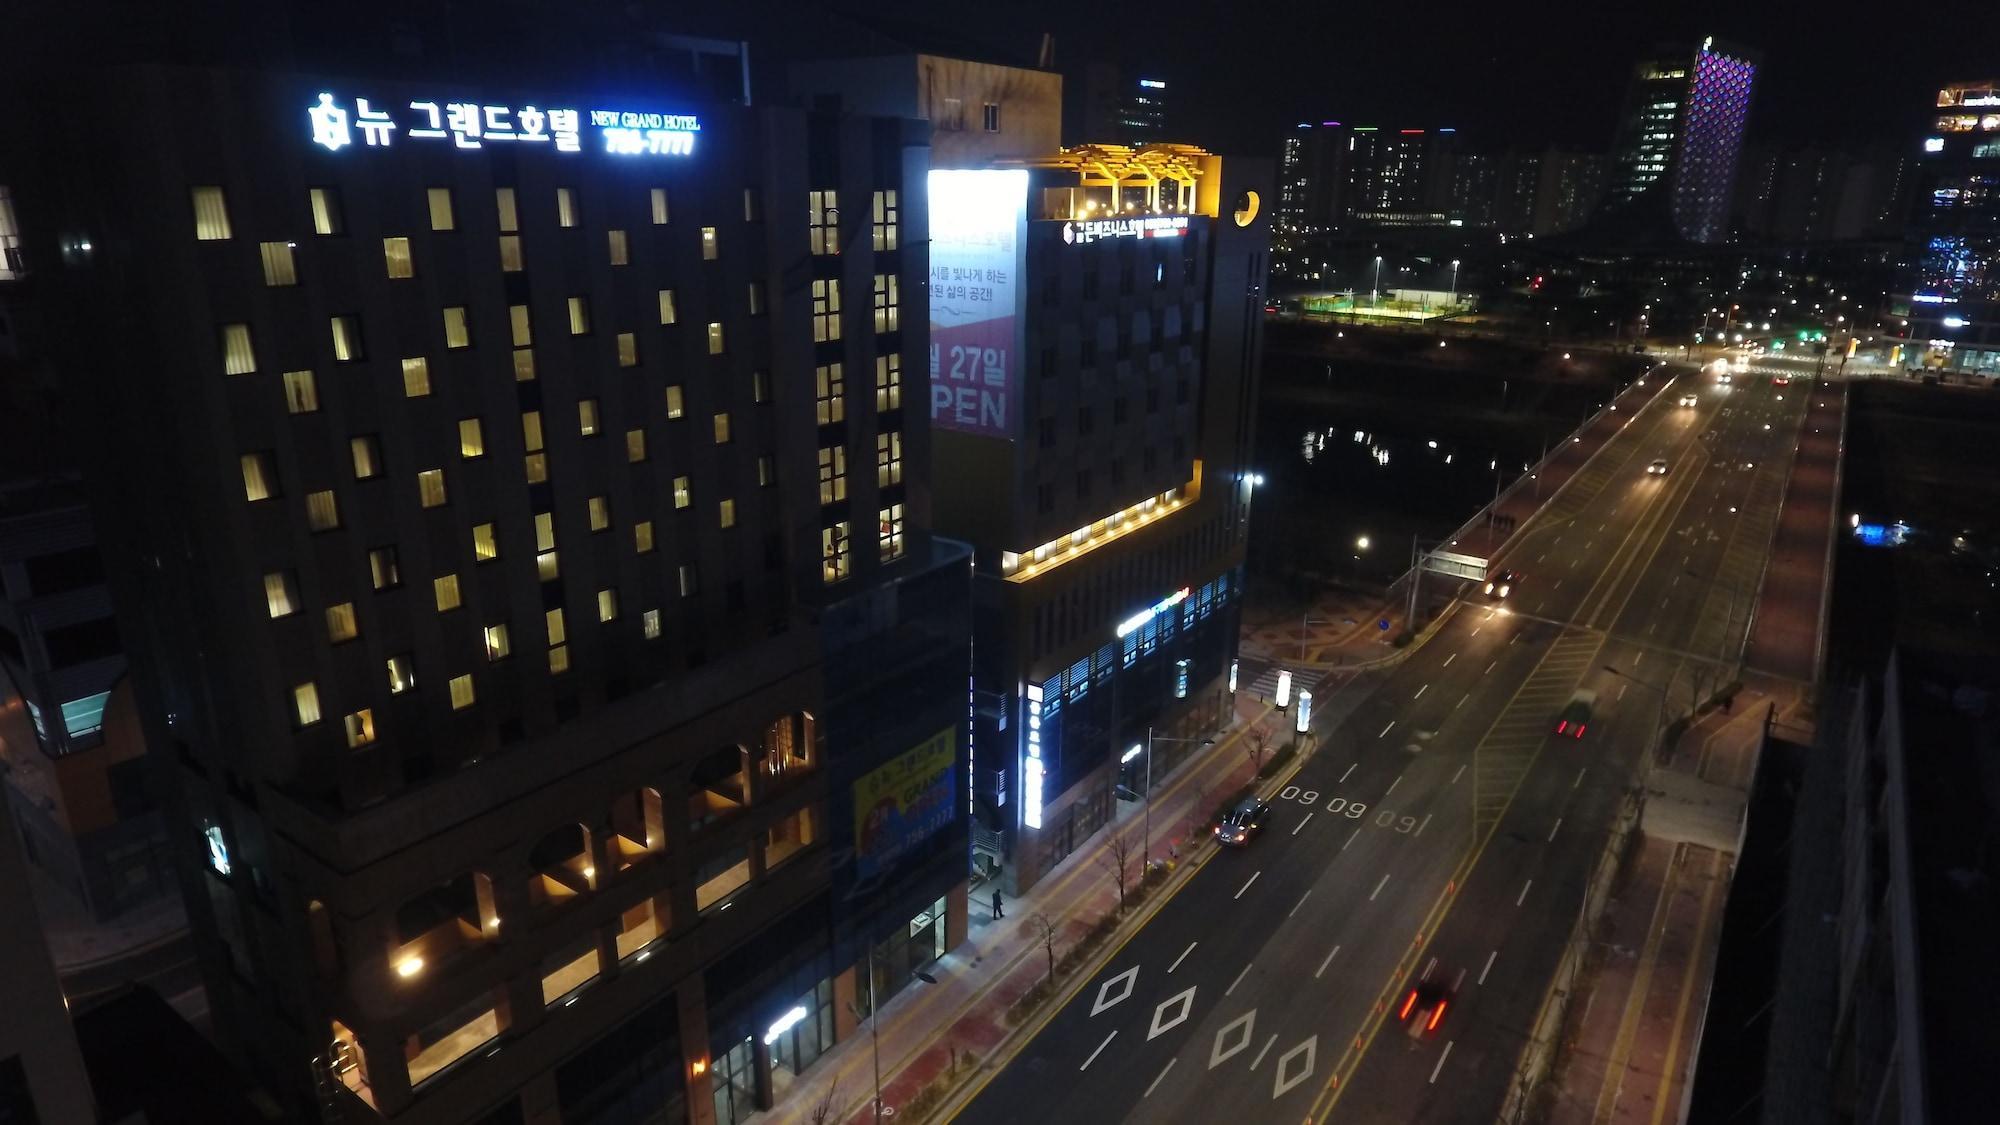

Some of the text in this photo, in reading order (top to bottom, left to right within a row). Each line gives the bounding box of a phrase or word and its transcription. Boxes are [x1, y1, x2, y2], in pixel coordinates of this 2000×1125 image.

[355, 97, 397, 146] 뉴
[590, 110, 701, 131] NEW GRAND HOTEL
[953, 267, 983, 282] 빛나게
[986, 269, 1007, 284] 하는
[950, 345, 1006, 387] 27일
